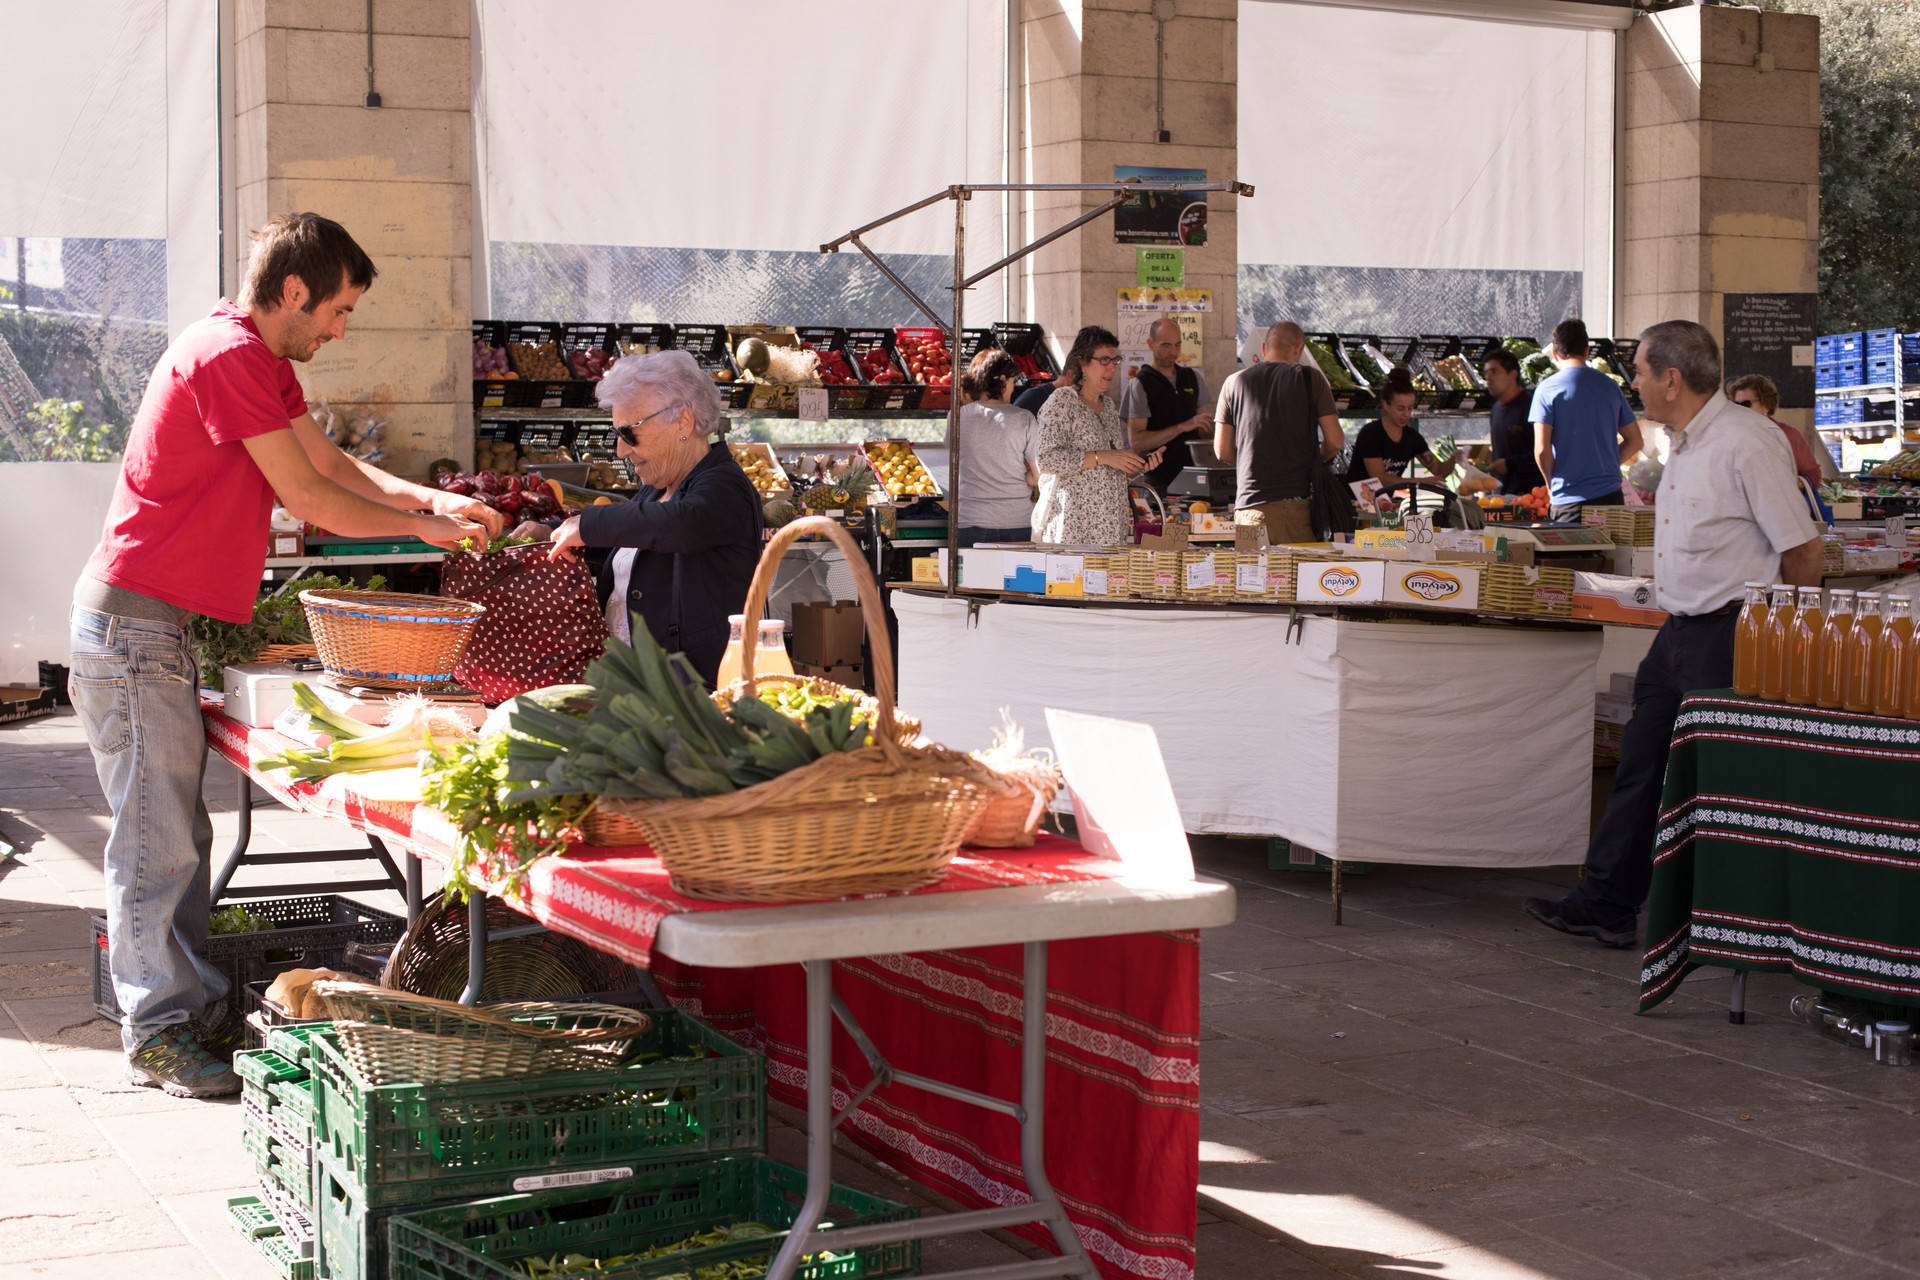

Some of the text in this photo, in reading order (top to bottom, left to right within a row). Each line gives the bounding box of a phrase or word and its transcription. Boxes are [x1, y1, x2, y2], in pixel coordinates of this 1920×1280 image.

[1145, 252, 1176, 260] OFERTA
[1405, 515, 1434, 544] 5'85
[1324, 577, 1355, 588] Ketydul
[1411, 580, 1454, 592] Ketydul
